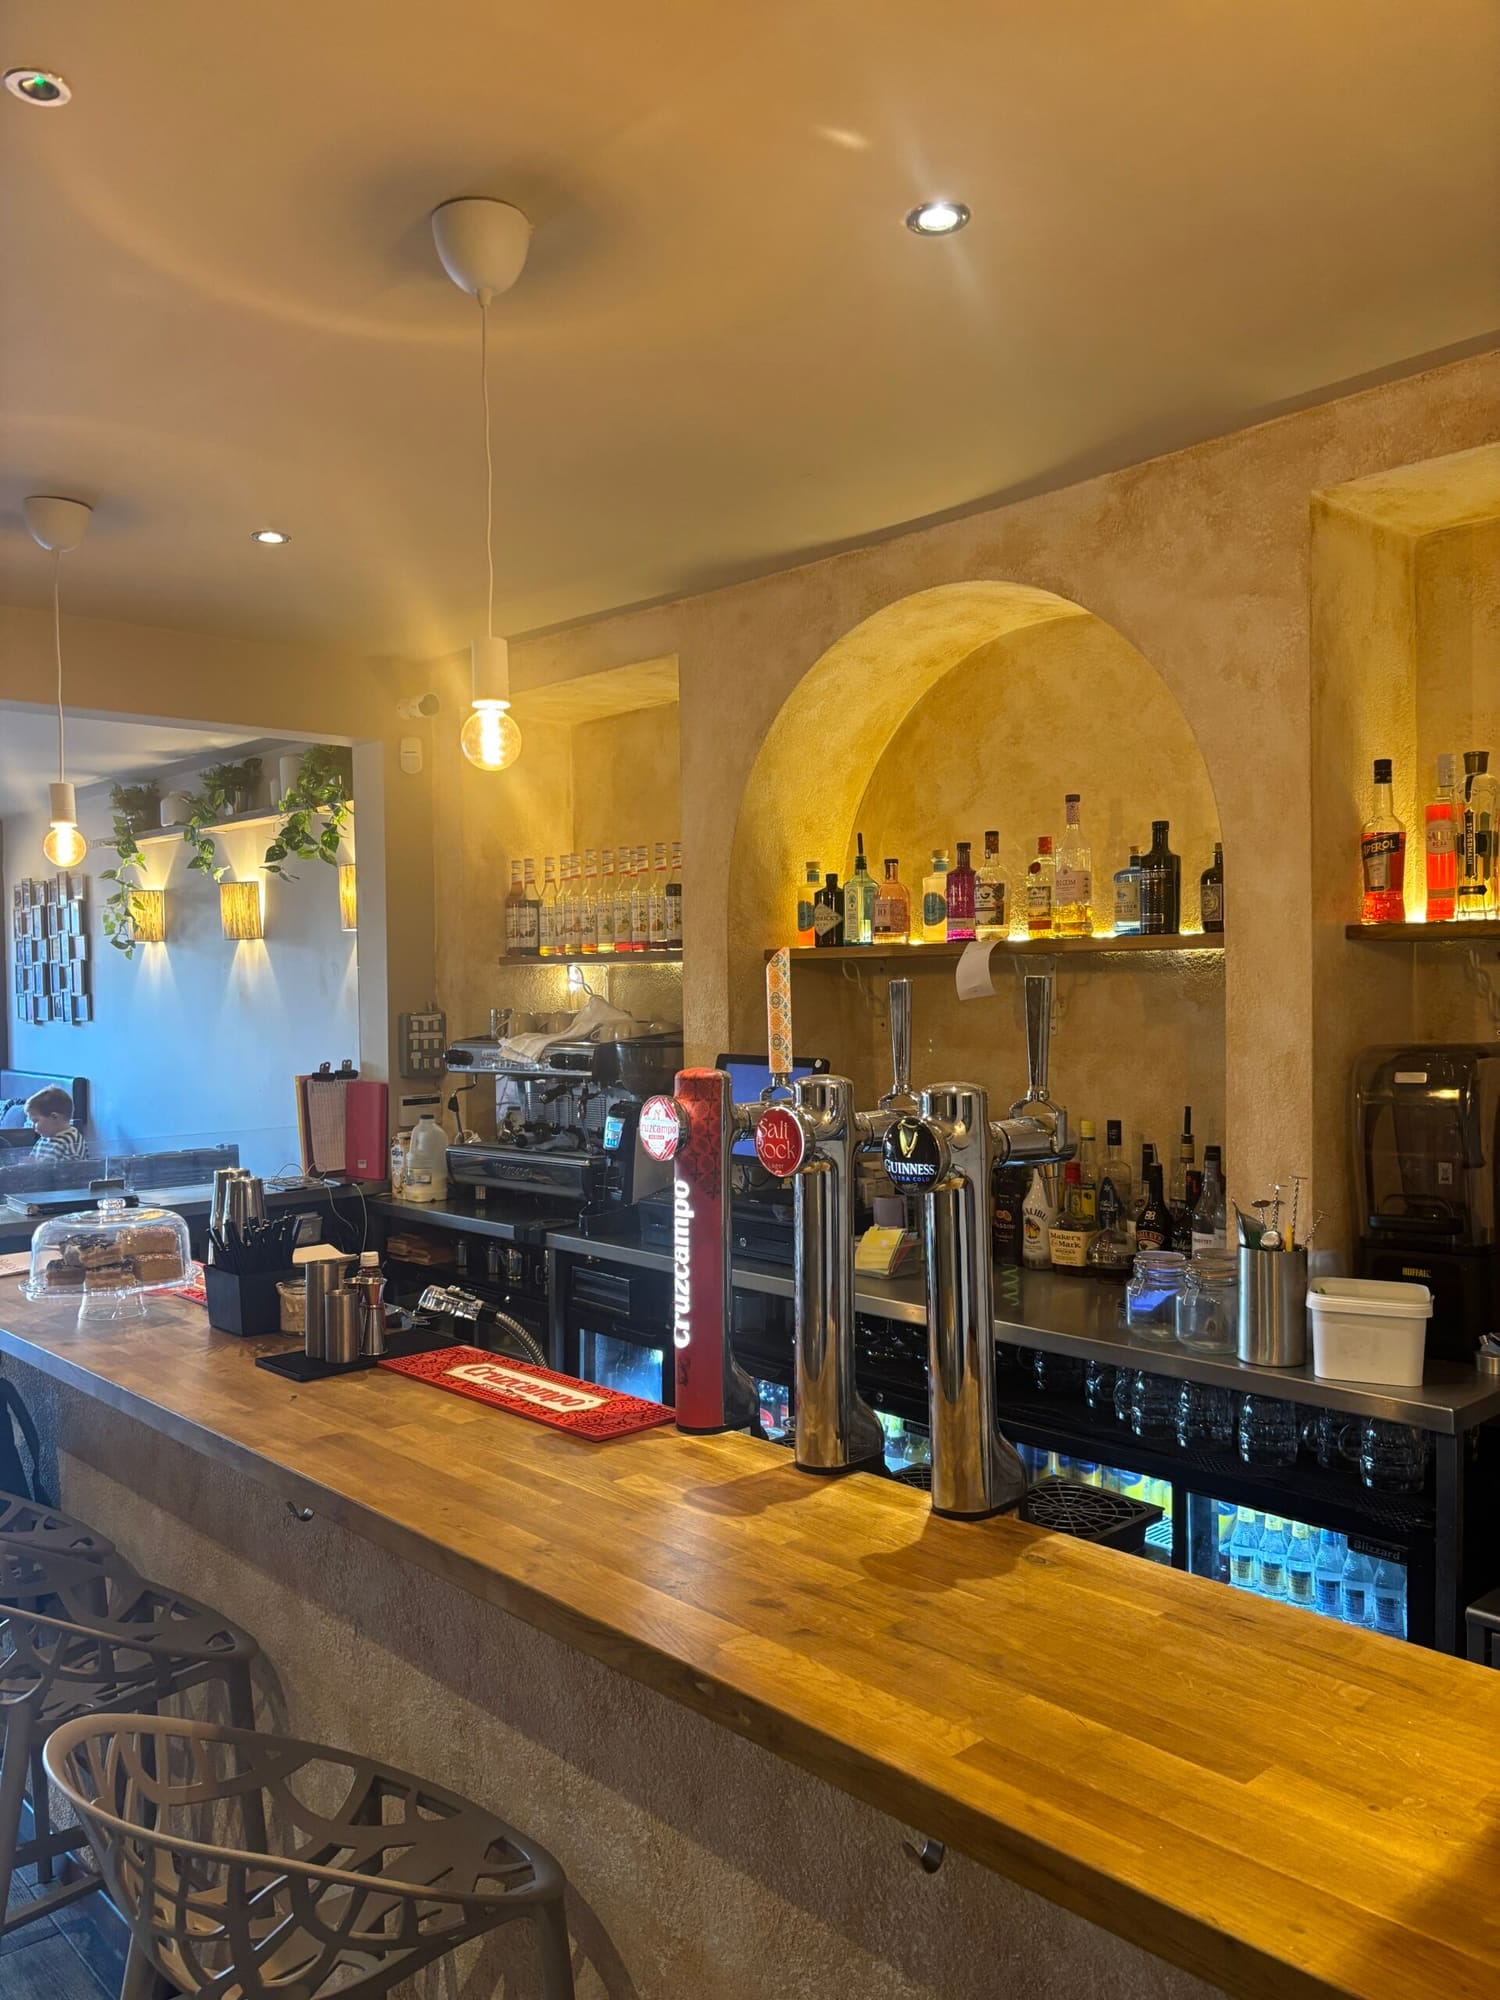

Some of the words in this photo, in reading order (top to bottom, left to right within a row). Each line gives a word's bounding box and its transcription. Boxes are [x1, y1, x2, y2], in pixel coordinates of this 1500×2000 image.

[760, 1118, 788, 1140] Salt
[758, 1140, 796, 1160] Rock
[884, 1158, 937, 1176] GUINNESS
[463, 1365, 586, 1408] Cruzcampo
[1353, 1539, 1400, 1560] Blizzard
